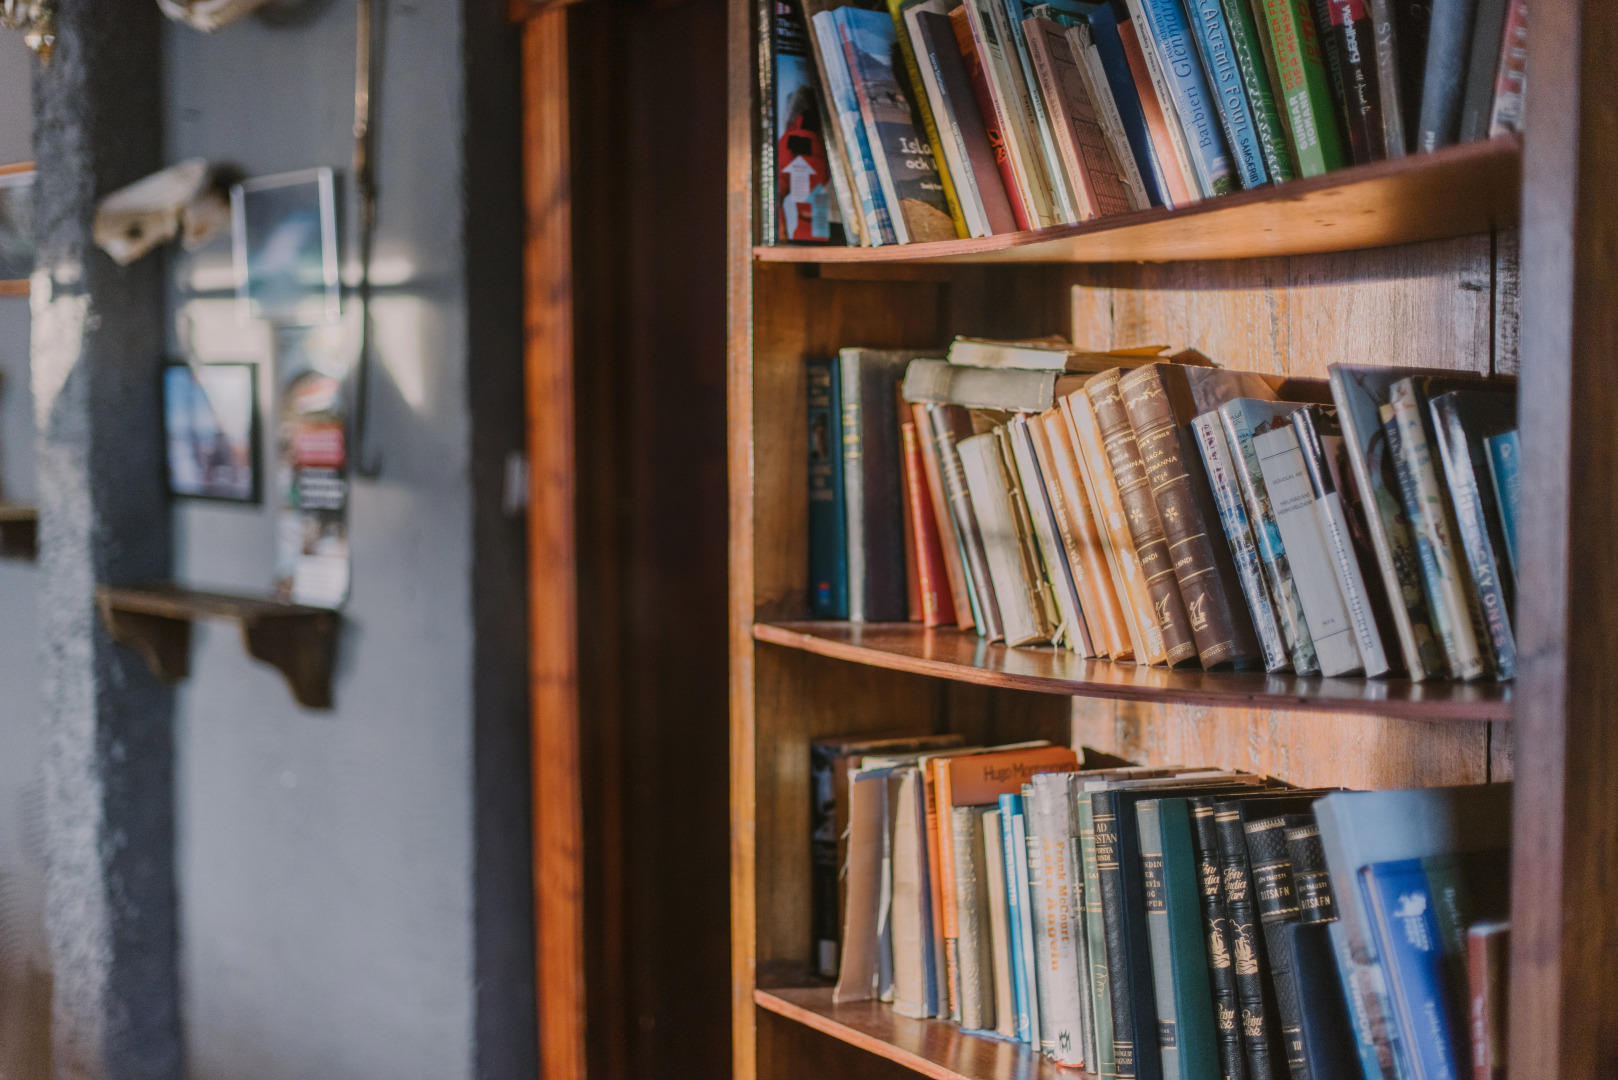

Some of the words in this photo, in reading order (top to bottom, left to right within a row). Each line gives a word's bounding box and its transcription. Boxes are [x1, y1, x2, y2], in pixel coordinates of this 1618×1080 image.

[1267, 0, 1277, 15] FR
[1271, 18, 1289, 69] LETZTEN
[1283, 71, 1294, 90] DIE
[1291, 57, 1304, 86] DER
[1184, 85, 1211, 149] Barbieri
[1289, 96, 1307, 150] GUNNAR
[1299, 91, 1317, 146] HOMANN
[1112, 453, 1129, 465] SAGA
[1146, 450, 1164, 462] SAGA
[1483, 593, 1507, 647] ONES
[1042, 837, 1056, 889] Aska
[1056, 841, 1067, 881] Frank
[1058, 885, 1069, 942] McCourt
